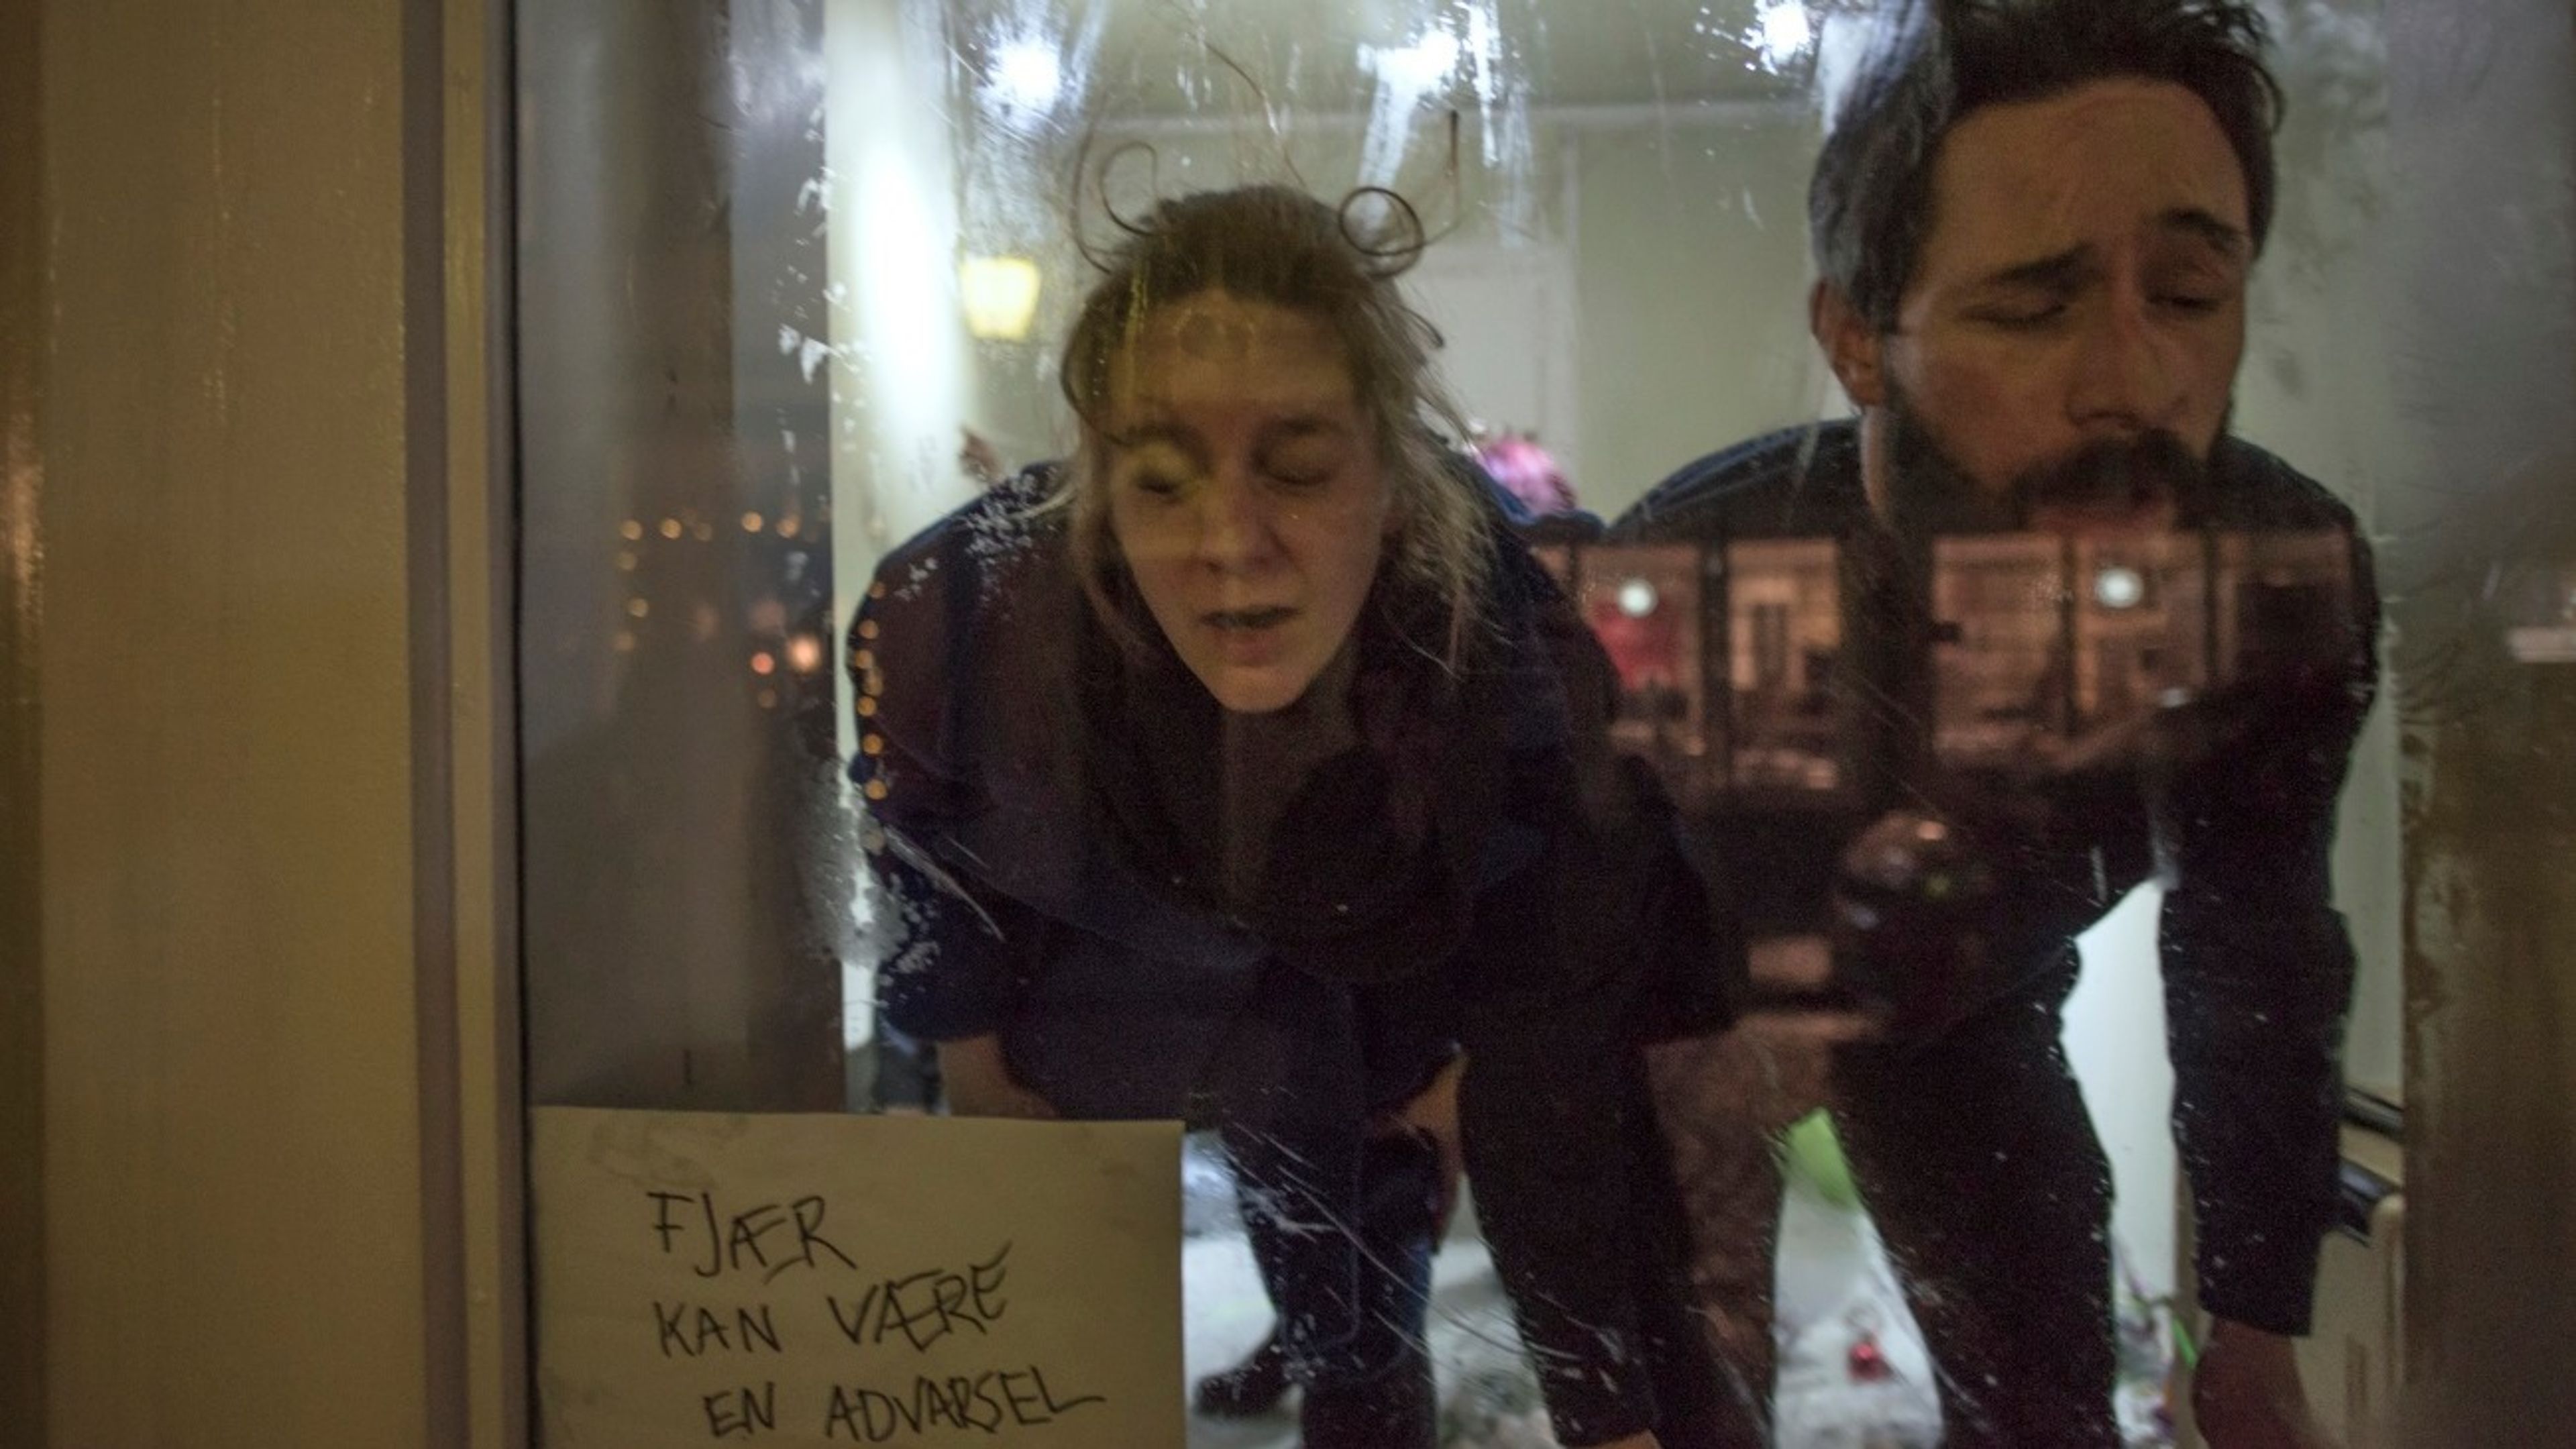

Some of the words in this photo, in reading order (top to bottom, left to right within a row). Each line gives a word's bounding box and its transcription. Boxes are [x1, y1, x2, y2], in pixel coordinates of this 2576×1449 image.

[646, 1191, 857, 1285] FJÆR
[653, 1301, 783, 1358] KAN
[827, 1240, 1013, 1352] VÆRE
[703, 1381, 776, 1438] EN
[824, 1366, 1107, 1443] ADVARSEL
